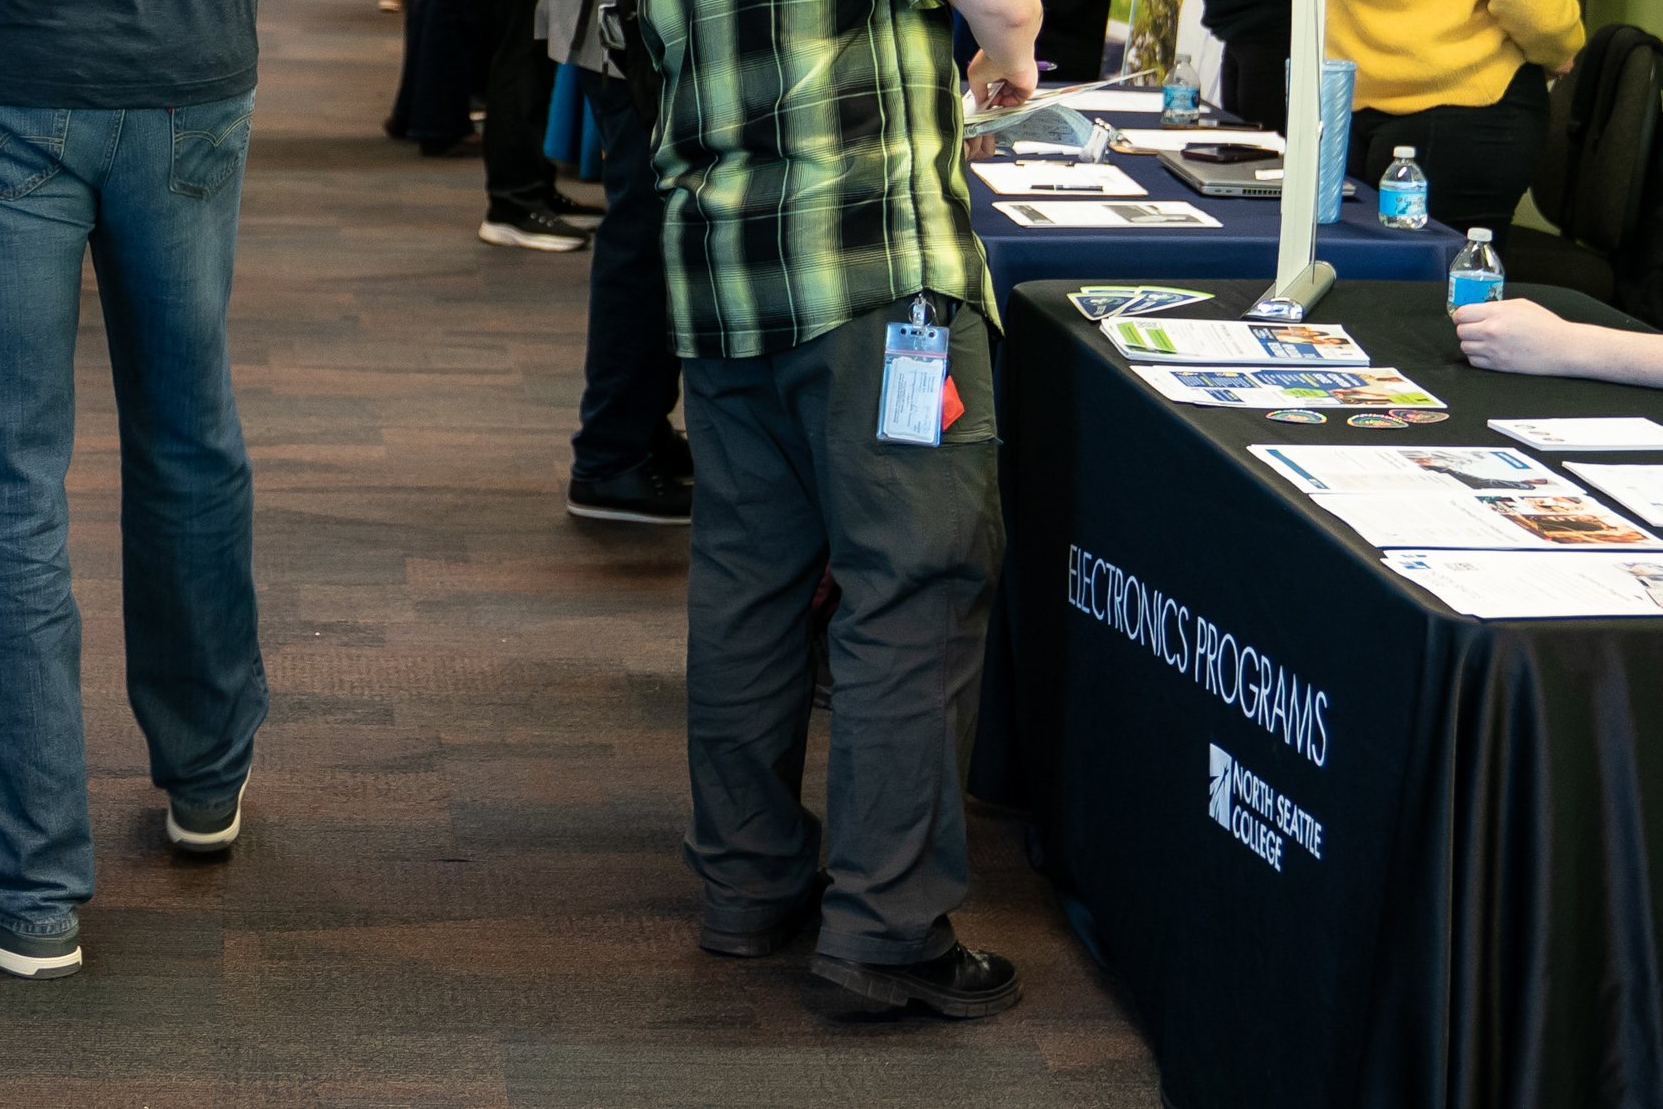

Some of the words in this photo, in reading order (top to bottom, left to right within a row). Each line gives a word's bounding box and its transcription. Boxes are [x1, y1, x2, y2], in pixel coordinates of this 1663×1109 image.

[1068, 543, 1190, 674] ELECTRONICS
[1194, 615, 1329, 768] PROGRAMS
[1231, 804, 1283, 872] COLLEGE
[1232, 765, 1273, 822] NORTH
[1276, 793, 1324, 860] SEATTLE
